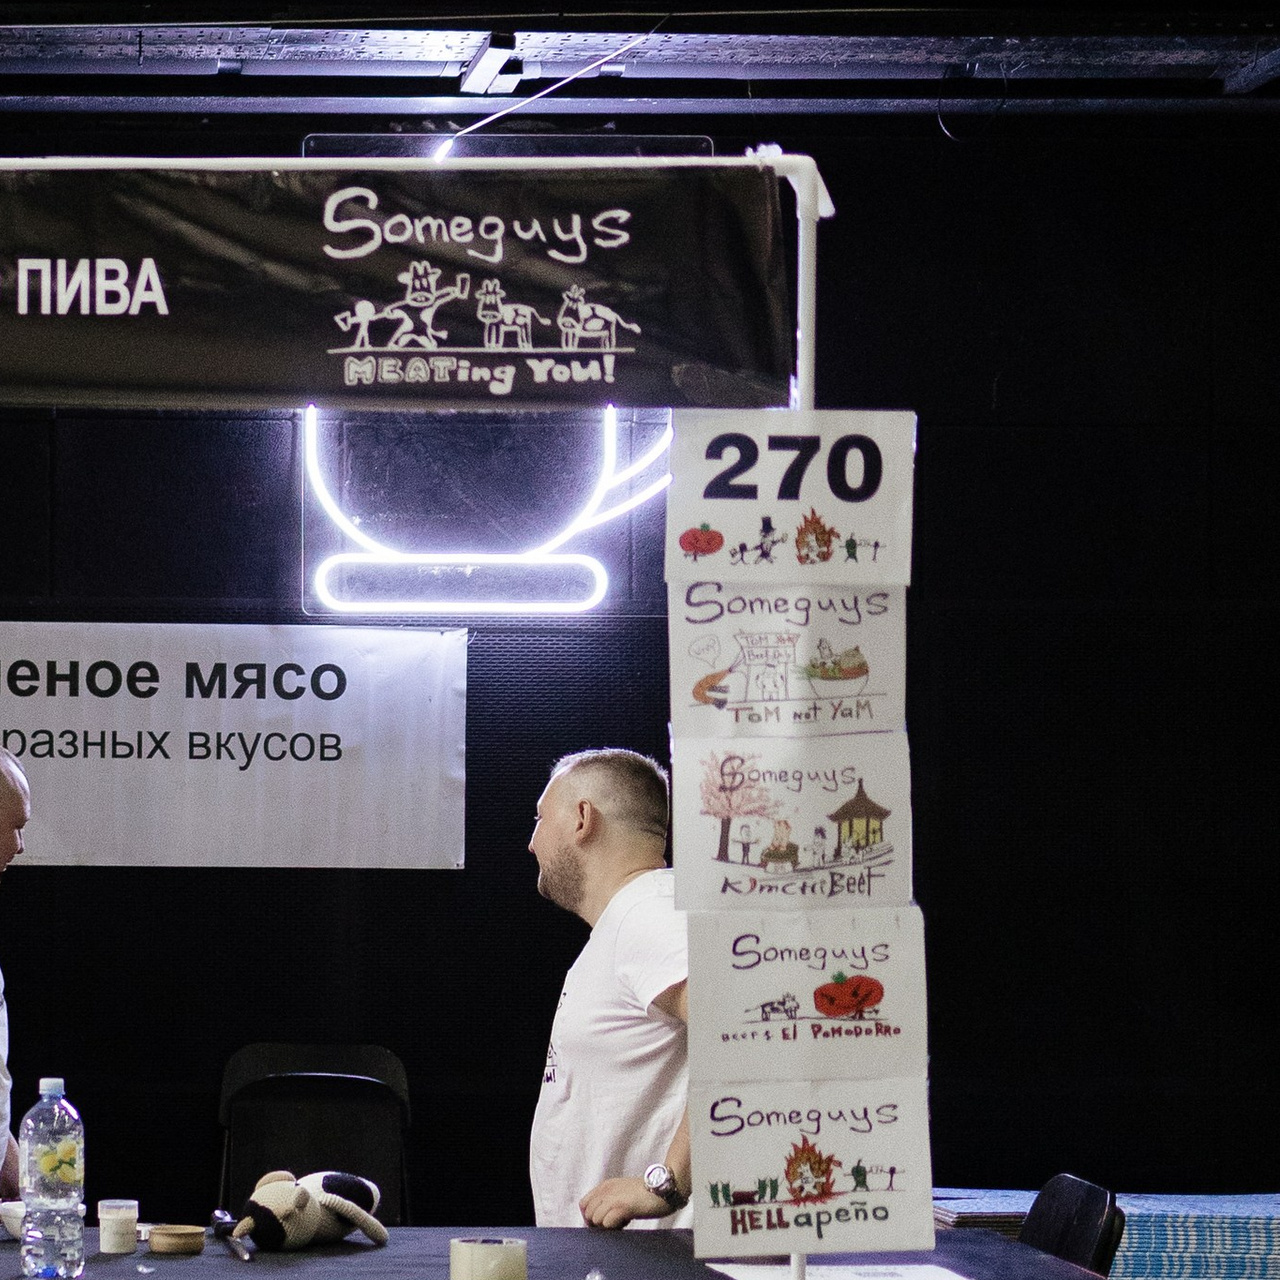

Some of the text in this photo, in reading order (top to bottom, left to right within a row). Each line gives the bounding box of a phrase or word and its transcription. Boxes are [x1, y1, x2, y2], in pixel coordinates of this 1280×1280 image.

[323, 186, 631, 263] Someguys
[17, 257, 169, 315] ПИВА
[703, 432, 883, 503] 270
[684, 581, 890, 625] Someguys
[185, 661, 347, 701] мясо
[2, 726, 343, 772] разных вкусов
[719, 755, 856, 793] Someguys
[731, 932, 890, 975] Someguys
[708, 1096, 899, 1137] Someguys
